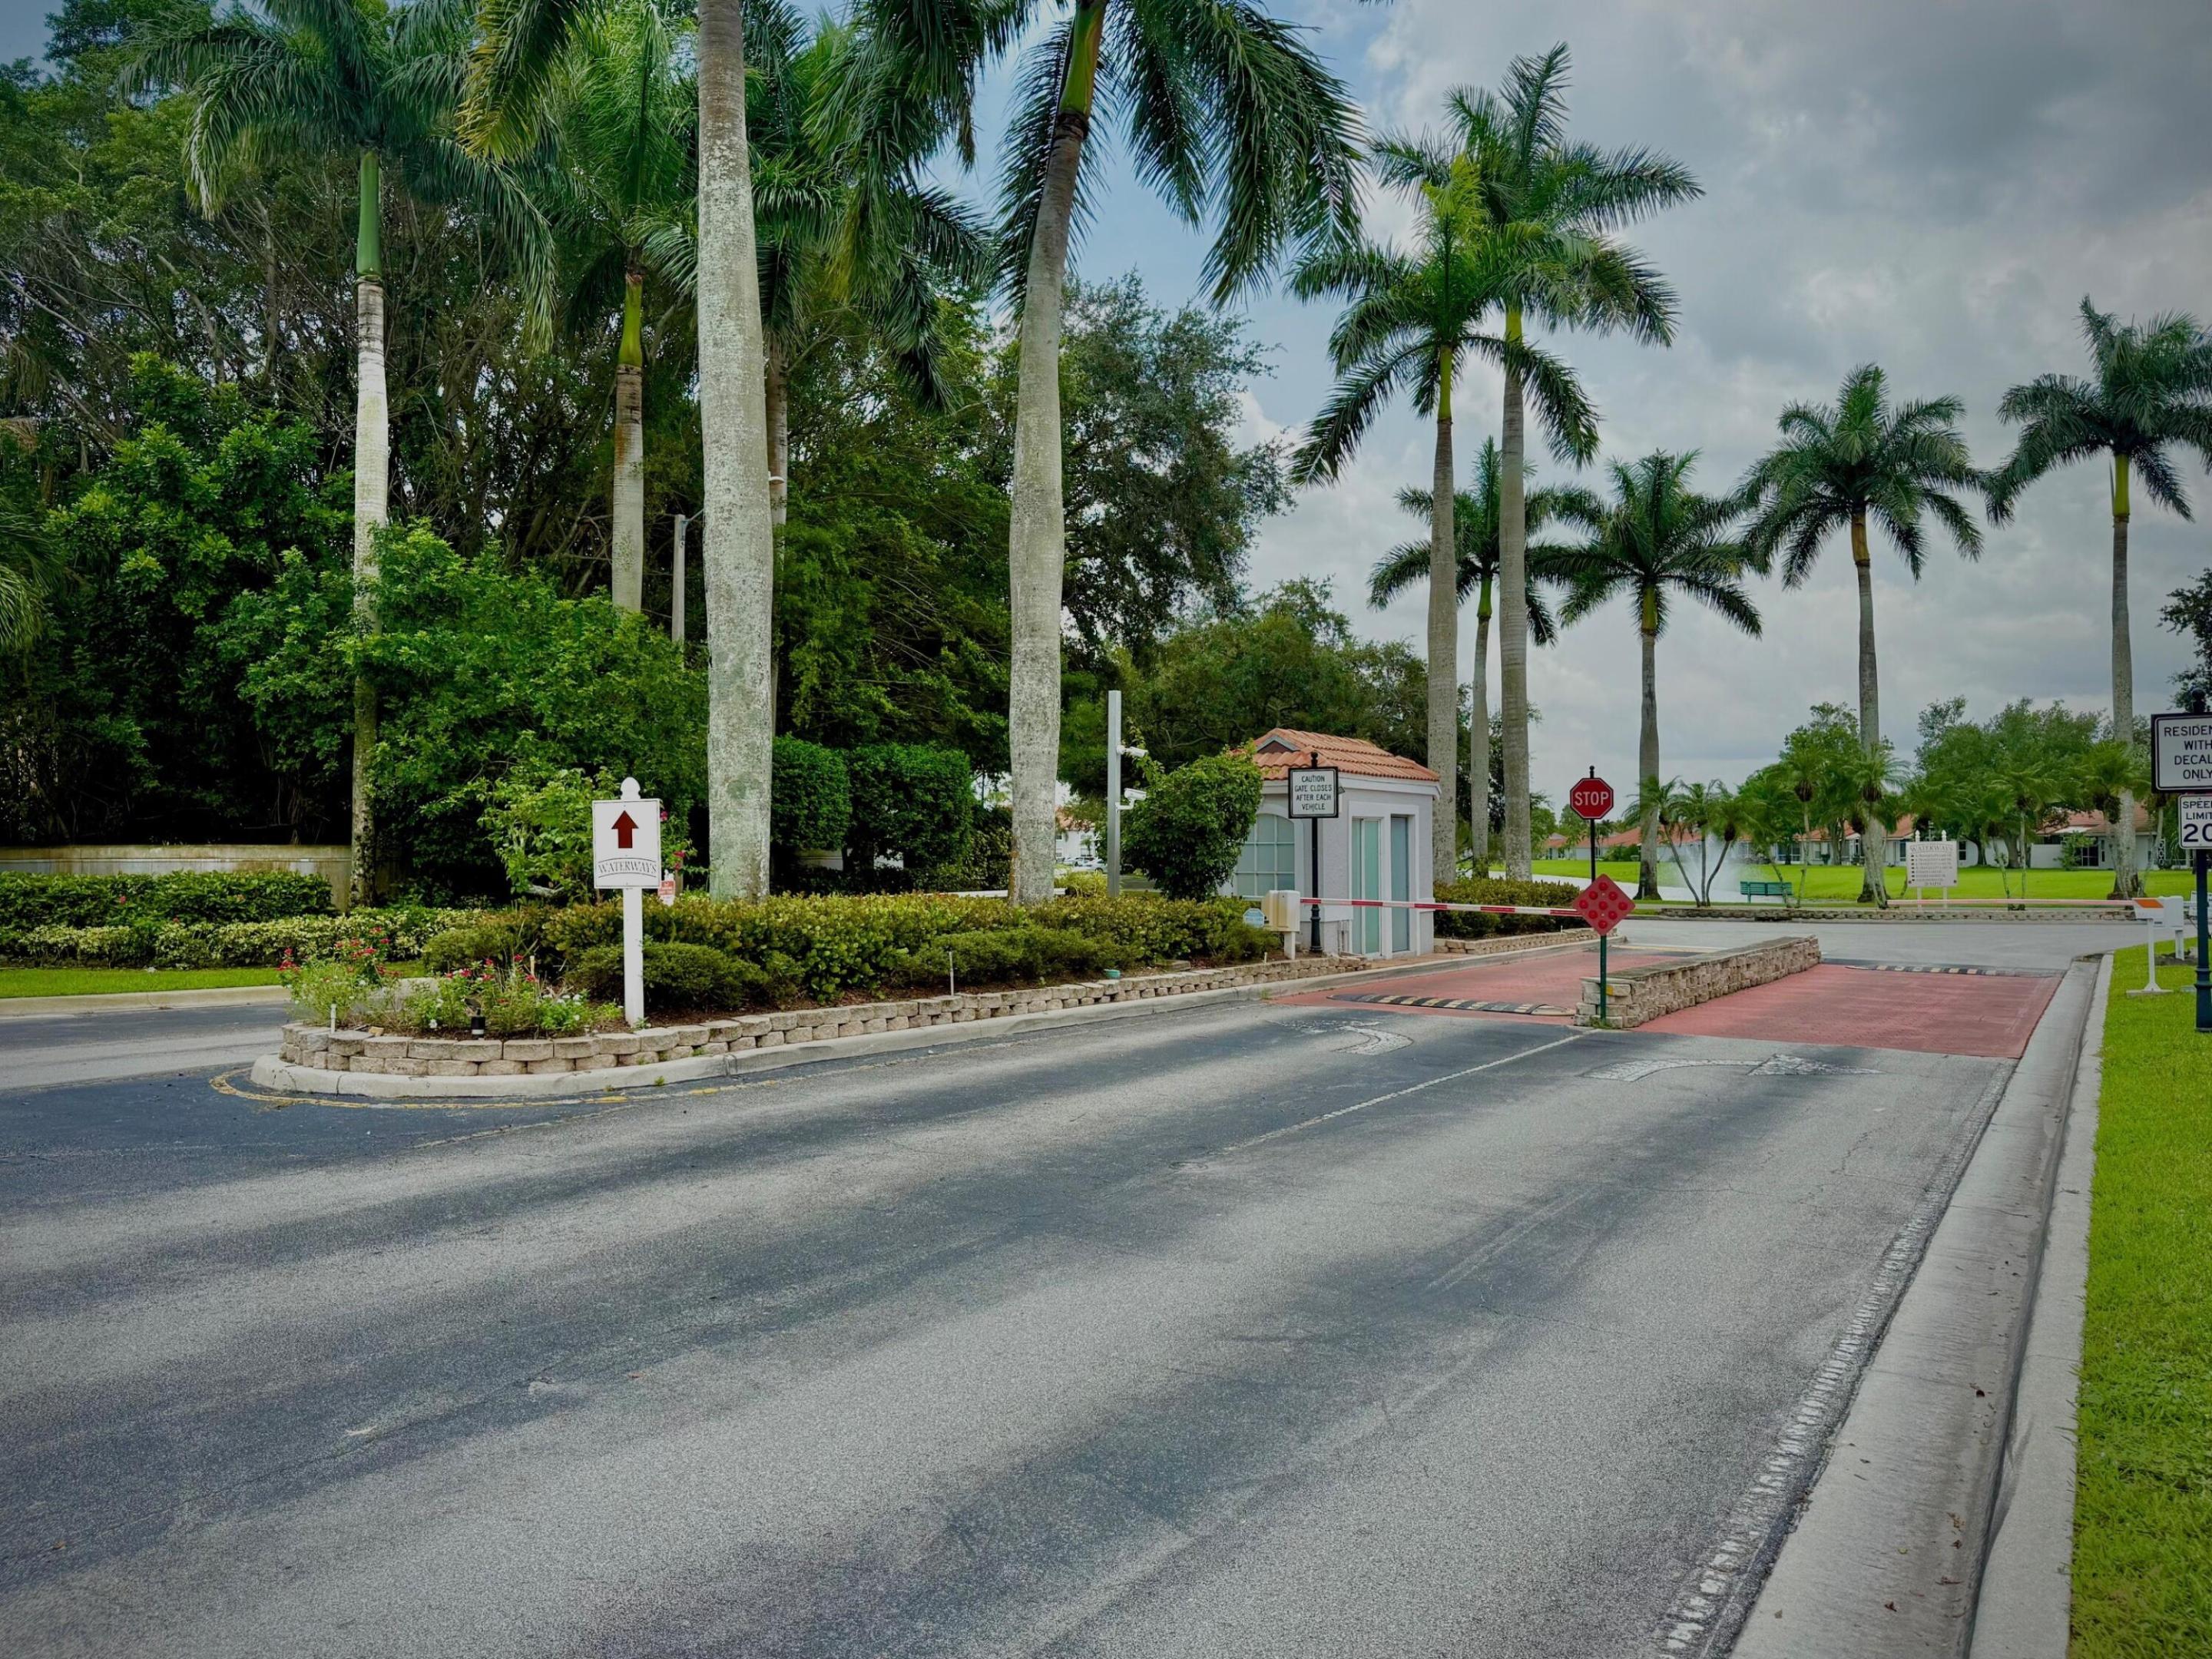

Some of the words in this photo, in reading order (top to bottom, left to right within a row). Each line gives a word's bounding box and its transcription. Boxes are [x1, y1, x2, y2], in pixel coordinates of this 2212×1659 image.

[2184, 740, 2212, 750] WITH
[2174, 754, 2212, 765] DECAL
[2183, 769, 2212, 780] ONLY
[1575, 791, 1609, 806] STOP
[2184, 823, 2212, 842] 20
[598, 860, 657, 873] WATERWAYS
